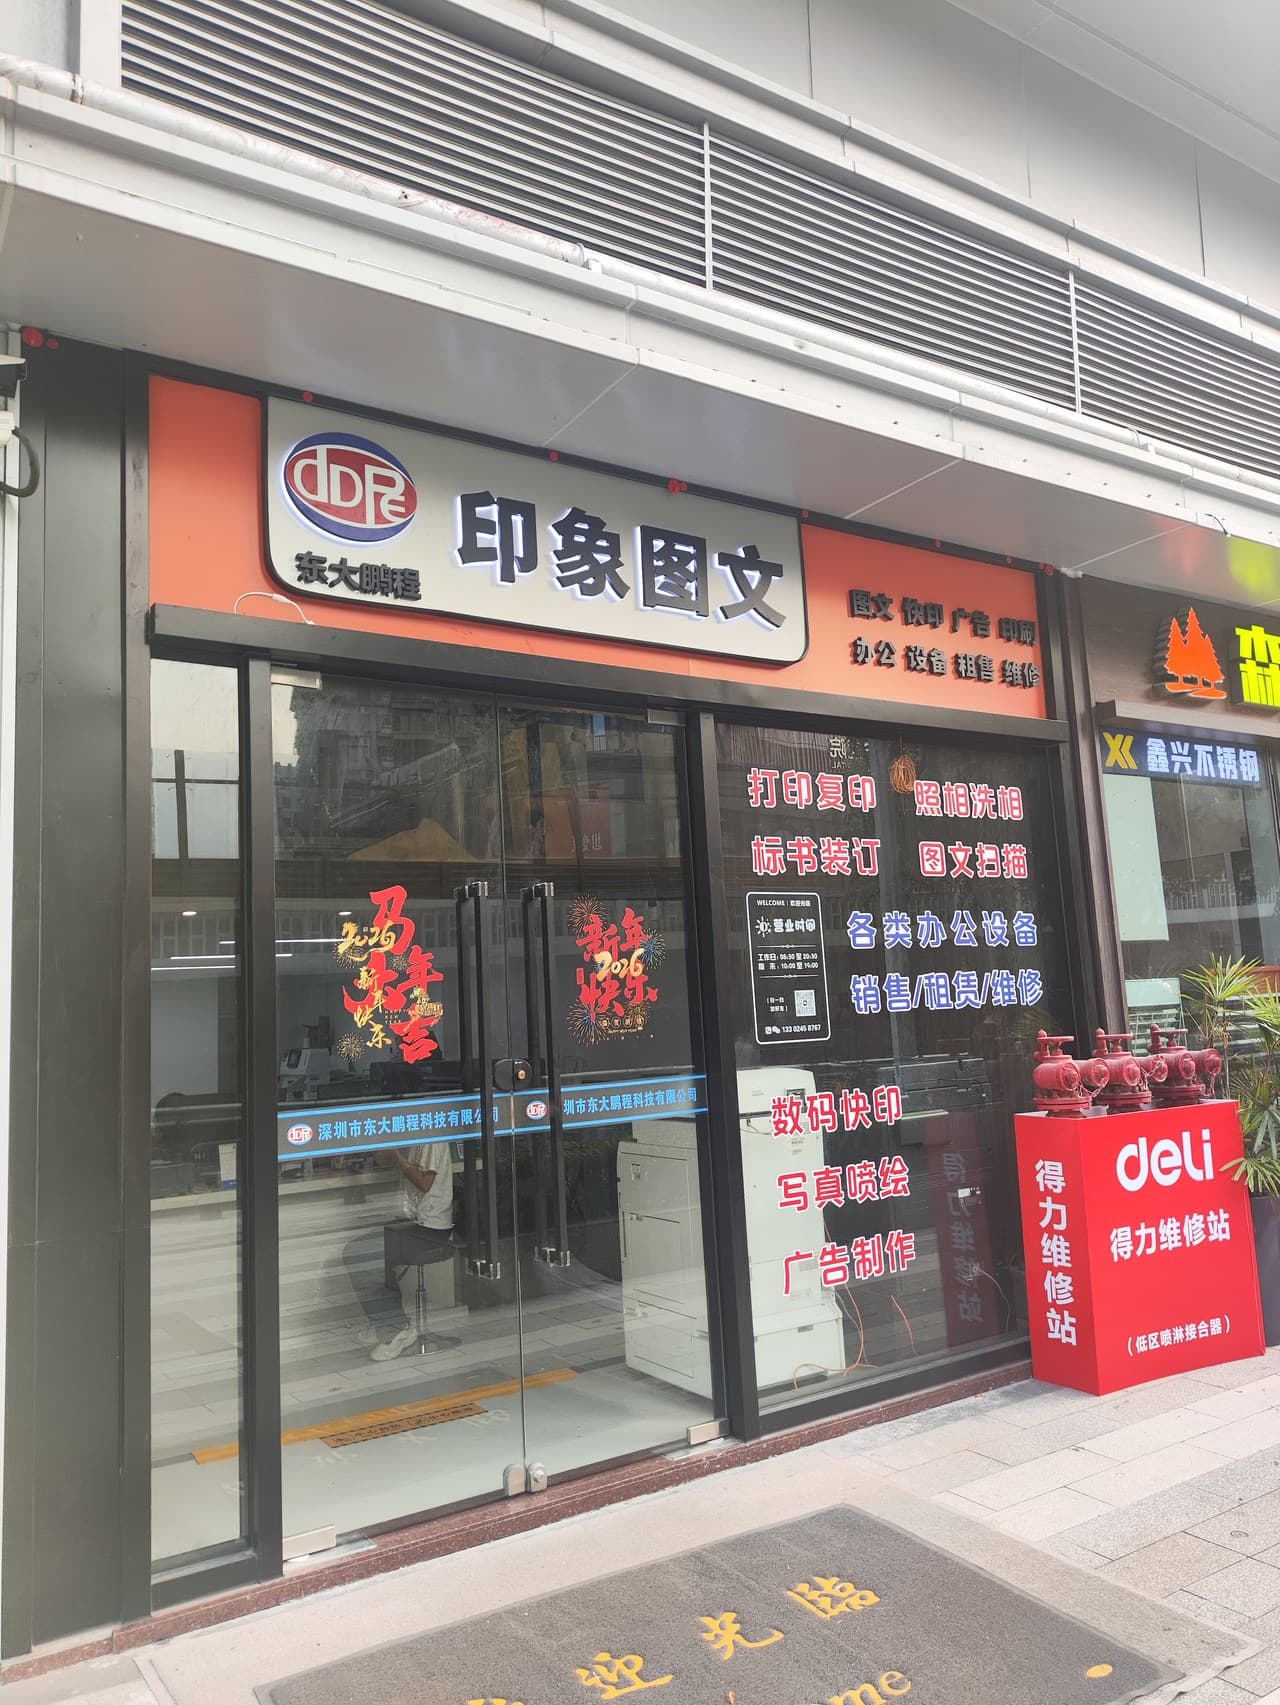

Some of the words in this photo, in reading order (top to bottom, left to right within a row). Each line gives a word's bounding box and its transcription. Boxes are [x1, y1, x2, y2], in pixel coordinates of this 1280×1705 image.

[294, 550, 422, 601] 东大鹏程
[456, 490, 787, 630] 印象图文
[849, 589, 894, 621] 图文
[901, 596, 945, 629] 快印
[951, 607, 991, 638] 广告
[997, 616, 1037, 647] 印刷
[852, 636, 897, 667] 办公
[905, 645, 948, 675] 设备
[953, 652, 994, 682] 租售
[999, 659, 1040, 689] 维修
[1146, 737, 1260, 782] 鑫兴不锈钢
[748, 768, 877, 812] 打印复印
[914, 780, 1024, 820] 照相洗相
[751, 836, 880, 876] 标书装订
[919, 841, 1029, 879] 图文扫描
[756, 899, 786, 907] WELCOME
[773, 917, 816, 933] 营业时间
[847, 911, 1038, 949] 各类办公设备
[594, 948, 645, 981] 2026
[850, 969, 1044, 1014] 销售/租赁/维修
[563, 1087, 697, 1115] 圳市东大鹏程科技有限公司
[771, 1085, 903, 1139] 数码快印
[1116, 1128, 1215, 1192] deli
[777, 1155, 912, 1213] 写真喷绘
[1034, 1159, 1078, 1347] 得力维修站
[1110, 1208, 1231, 1263] 得力维修站
[782, 1229, 917, 1298] 广告制作
[1127, 1315, 1231, 1356] （低区喷淋接合器）
